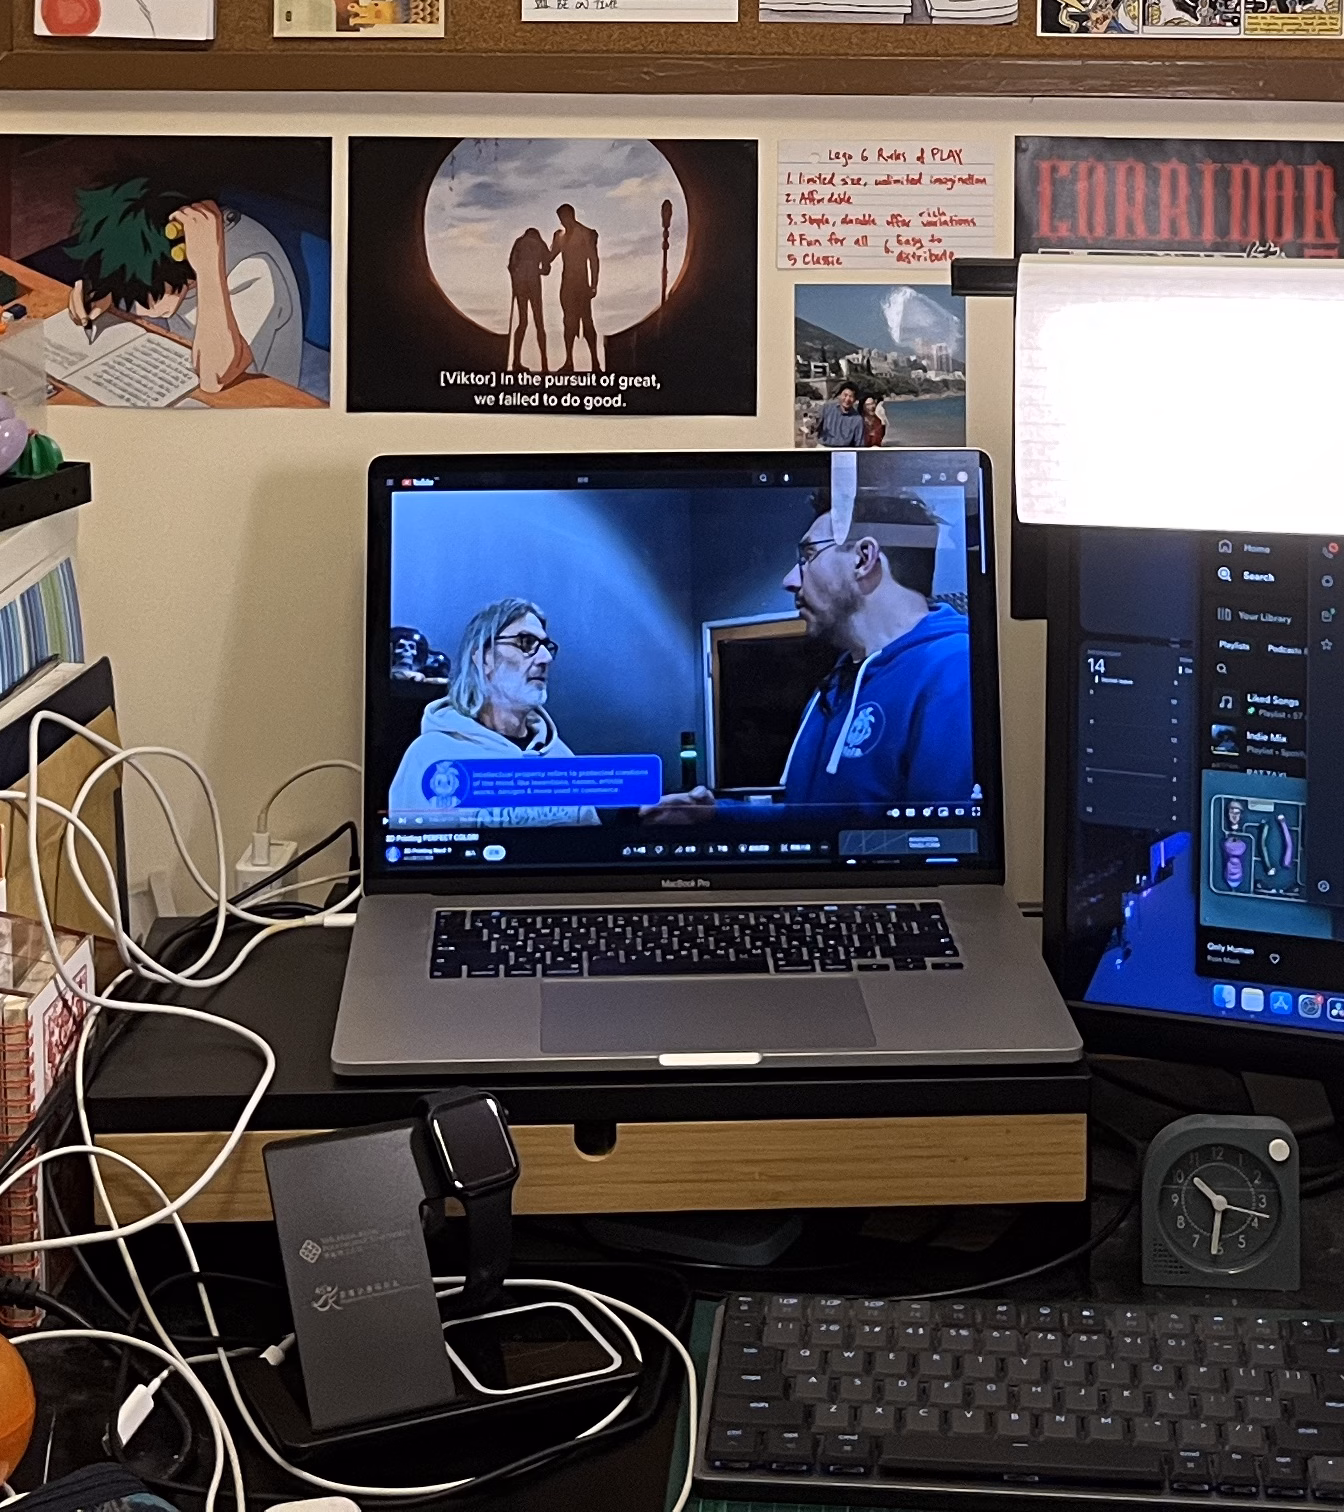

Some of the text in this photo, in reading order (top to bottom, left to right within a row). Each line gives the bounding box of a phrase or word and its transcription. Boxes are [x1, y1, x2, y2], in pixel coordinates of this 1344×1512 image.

[828, 149, 853, 167] Lego
[861, 148, 869, 162] 6
[877, 148, 907, 163] Rules
[931, 148, 963, 165] PLAY
[799, 172, 836, 186] limited
[875, 172, 923, 186] unlimited
[929, 175, 987, 190] imagination
[799, 232, 869, 247] Fun for all
[896, 234, 942, 250] Easy to
[803, 253, 843, 266] Classic
[896, 248, 955, 263] distribute
[440, 370, 661, 390] [Viktor] In the pursuit of great,
[474, 392, 627, 410] we failed to do good.
[1243, 570, 1275, 583] Search
[1087, 658, 1105, 674] 14
[697, 879, 710, 888] Pro
